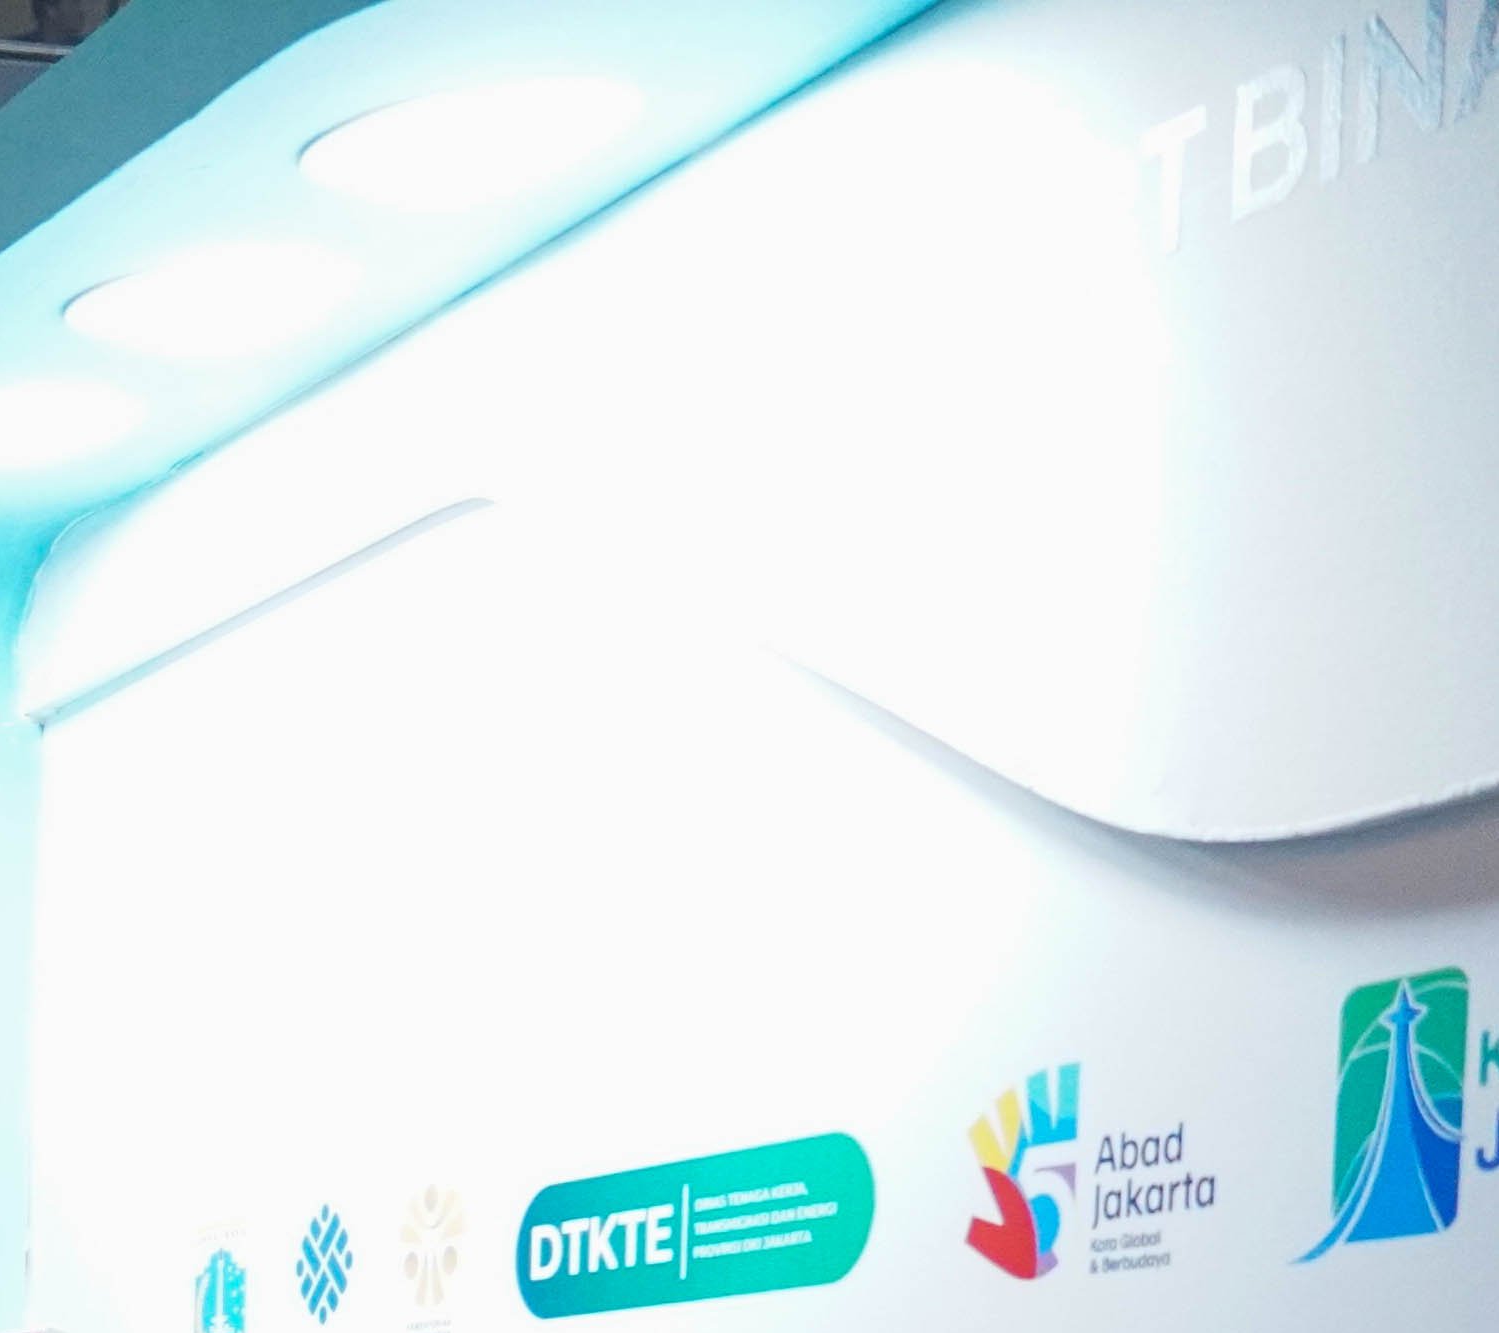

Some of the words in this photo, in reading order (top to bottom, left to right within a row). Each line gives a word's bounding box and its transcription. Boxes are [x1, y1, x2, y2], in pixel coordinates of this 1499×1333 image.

[1094, 1121, 1184, 1175] Abad
[1091, 1171, 1216, 1230] Jakarta
[528, 1203, 675, 1282] DTKTE
